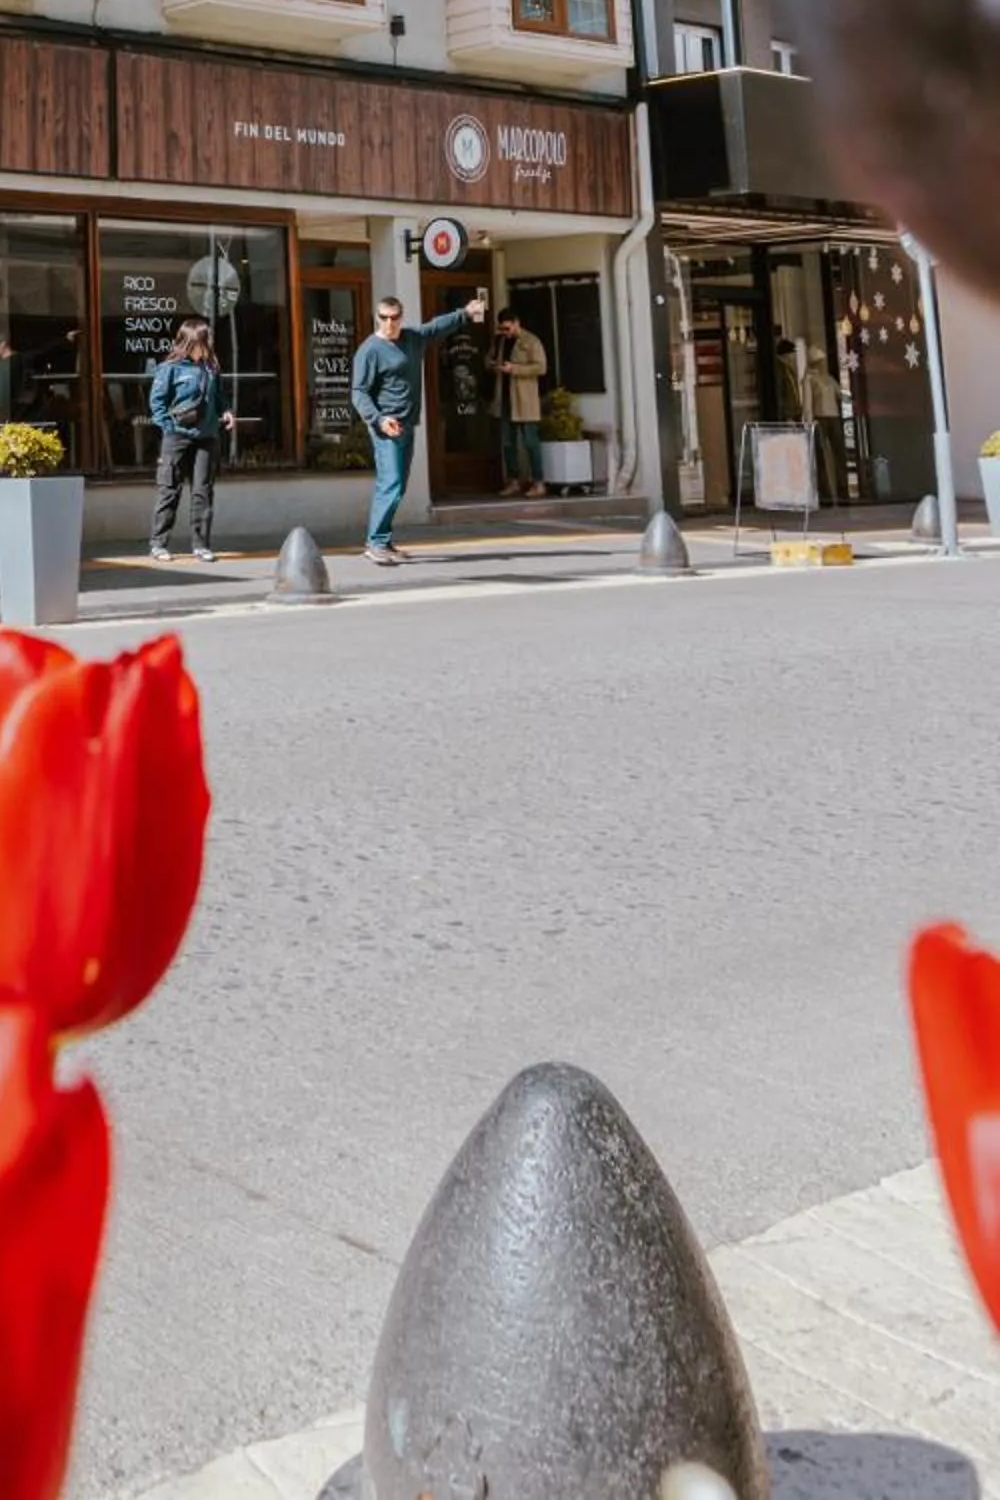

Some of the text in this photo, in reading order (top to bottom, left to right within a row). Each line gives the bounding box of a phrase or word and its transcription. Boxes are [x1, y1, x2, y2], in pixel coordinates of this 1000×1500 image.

[234, 121, 346, 147] FIN DEL MUNDO
[497, 123, 567, 166] MARCOPOLO
[123, 275, 155, 291] RICO
[124, 296, 177, 313] FRESCO
[125, 317, 173, 332] SANO Y
